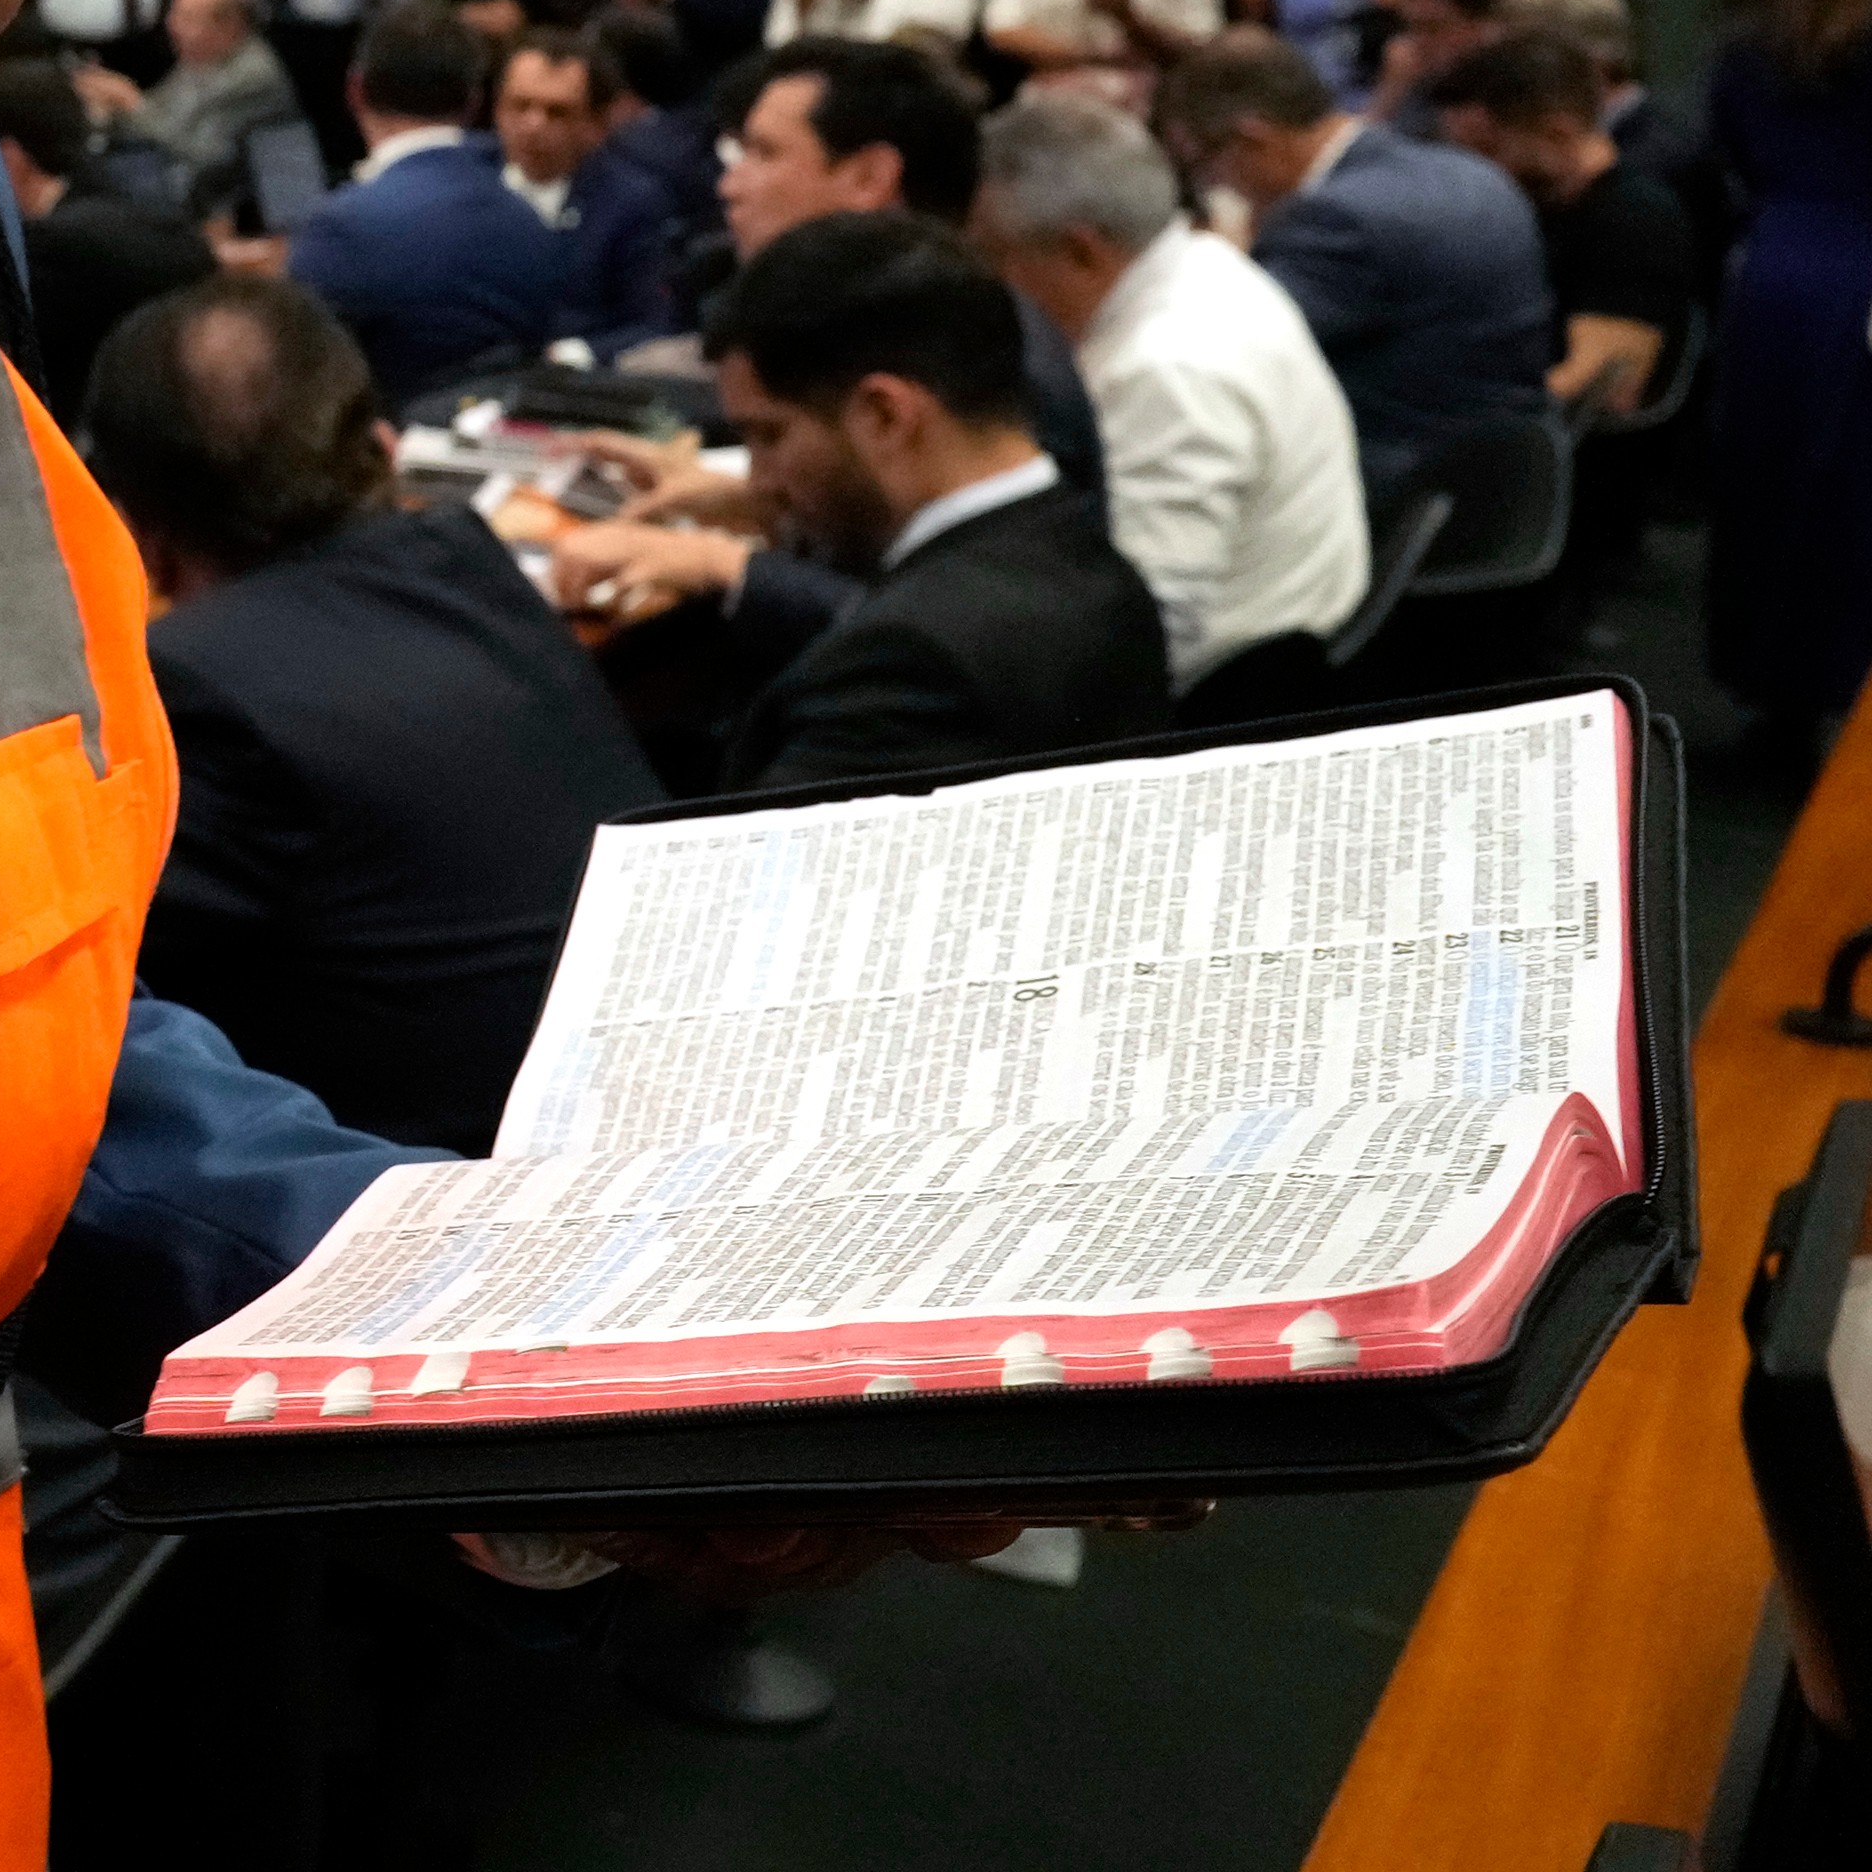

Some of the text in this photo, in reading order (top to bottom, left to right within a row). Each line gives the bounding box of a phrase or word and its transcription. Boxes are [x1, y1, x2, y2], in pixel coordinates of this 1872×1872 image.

[1499, 929, 1523, 943] 22
[1554, 924, 1579, 939] 21
[1391, 940, 1415, 955] 24
[1444, 933, 1468, 948] 23
[1013, 974, 1059, 1003] 18
